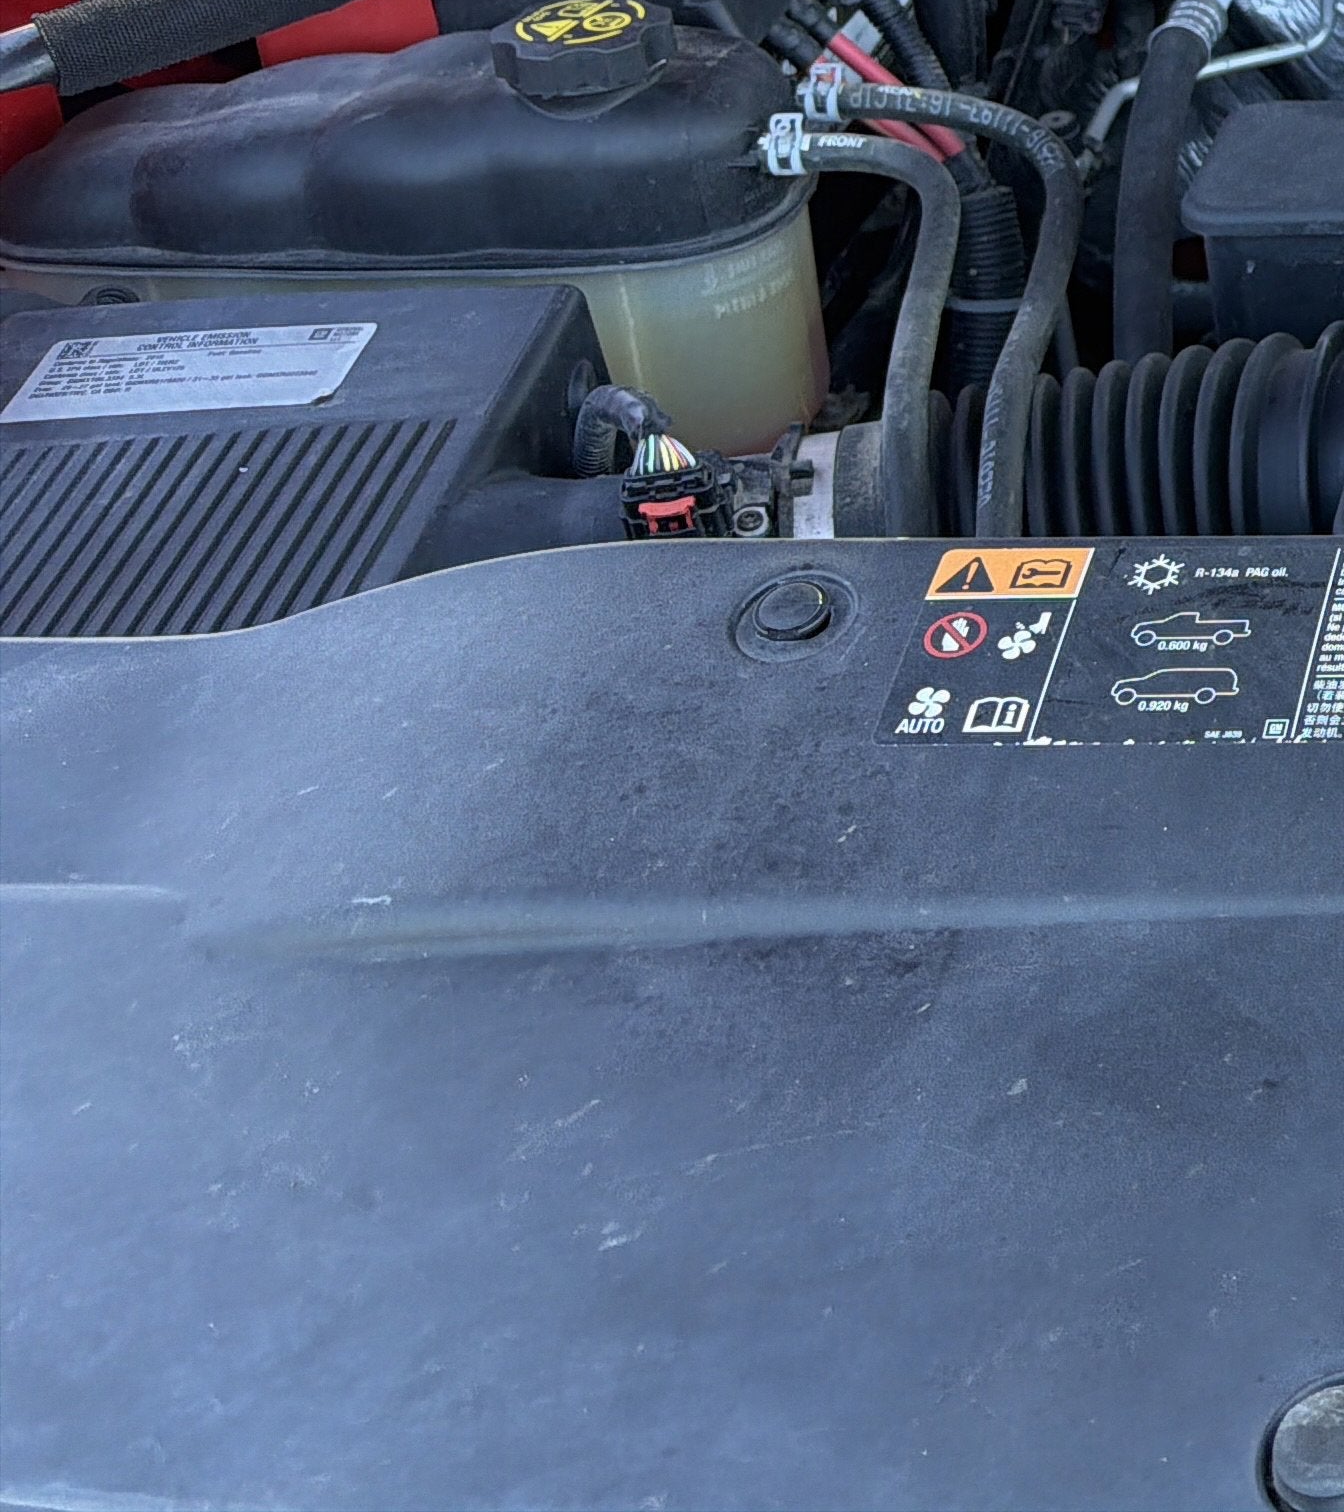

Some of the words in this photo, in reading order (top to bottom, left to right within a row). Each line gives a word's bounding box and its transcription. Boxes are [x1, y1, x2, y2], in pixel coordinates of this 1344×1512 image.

[817, 135, 866, 149] FRONT
[157, 333, 200, 344] VEHICLE
[202, 331, 252, 340] EMISSION
[137, 341, 184, 352] CONTROL
[186, 338, 259, 348] INFORMATION
[1195, 568, 1239, 578] R-134a
[1245, 567, 1269, 578] PAG
[1271, 567, 1289, 578] oil.
[1326, 623, 1340, 632] Ne
[1157, 641, 1191, 651] 0.600
[1192, 641, 1208, 652] kg
[1319, 653, 1332, 662] au
[1137, 700, 1172, 712] 0.920
[1173, 700, 1190, 713] kg
[894, 717, 946, 735] AUTO
